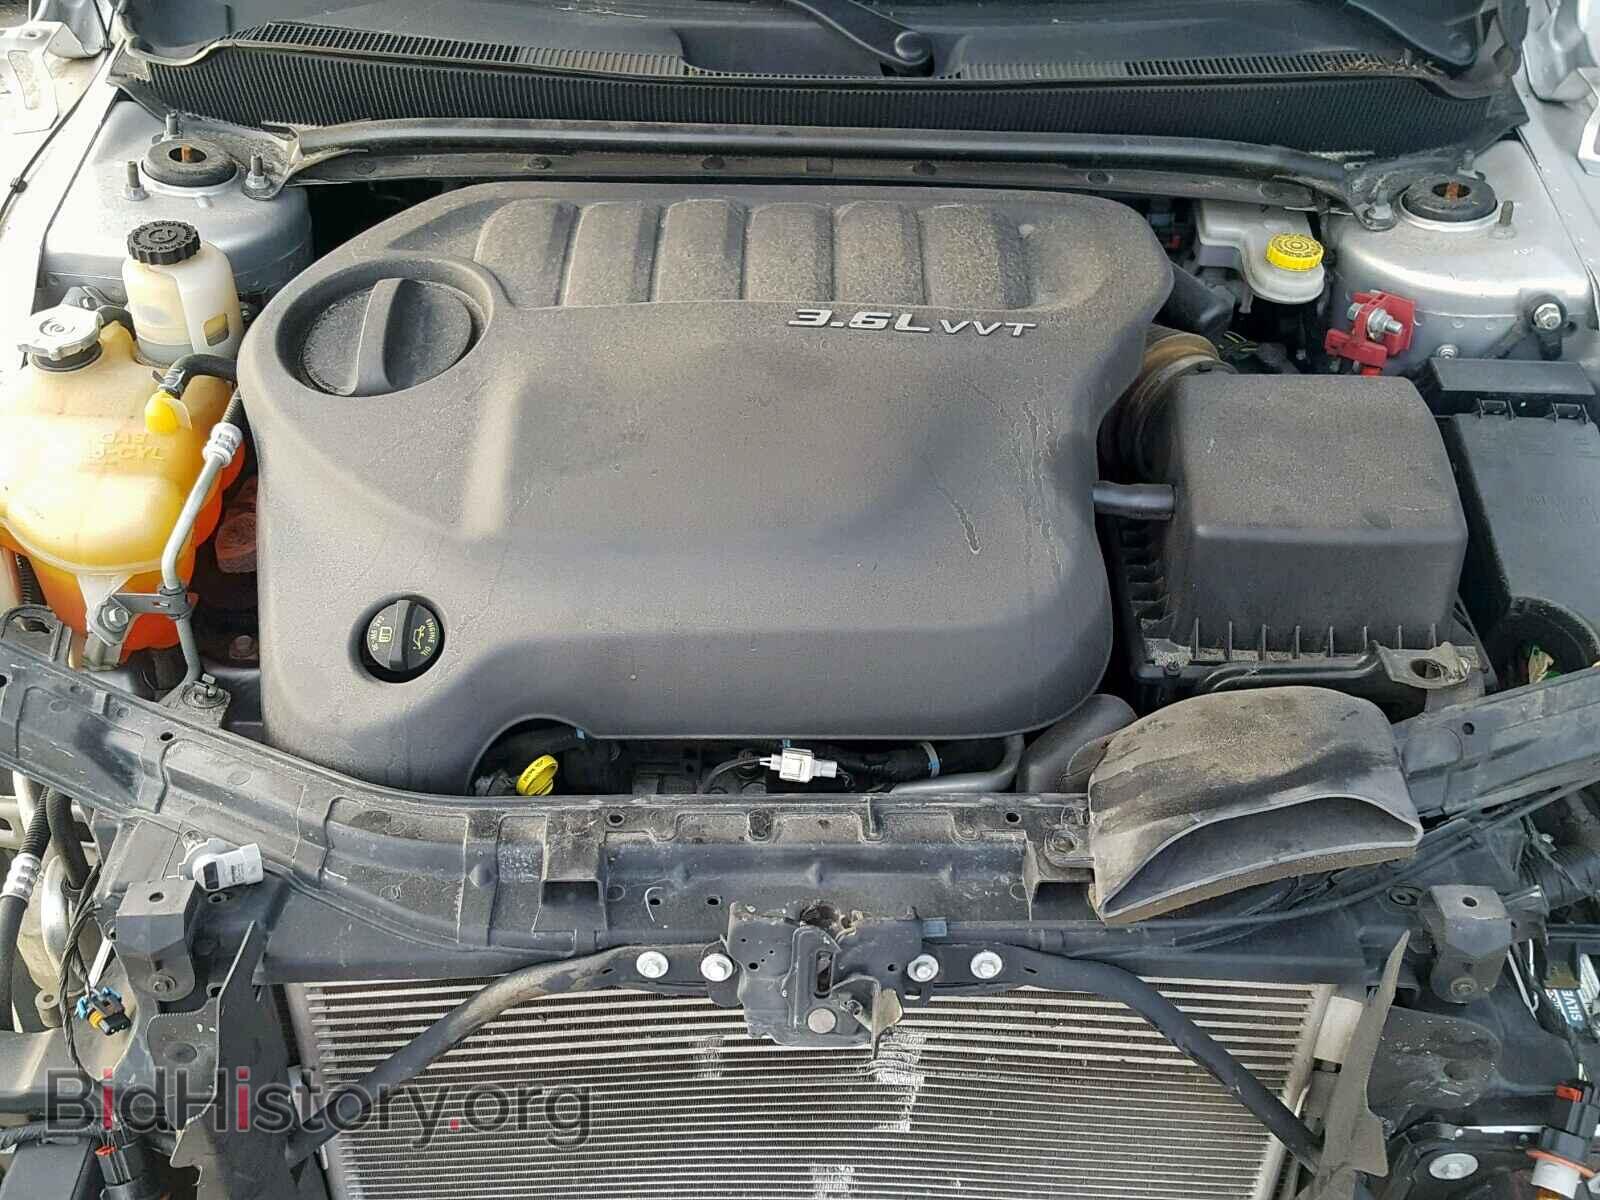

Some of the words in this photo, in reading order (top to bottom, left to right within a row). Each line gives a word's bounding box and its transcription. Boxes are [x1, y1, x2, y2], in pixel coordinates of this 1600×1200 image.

[788, 309, 931, 333] 3.6L
[940, 319, 1037, 337] VVT
[425, 618, 436, 643] ENGINE
[420, 646, 432, 657] OIL
